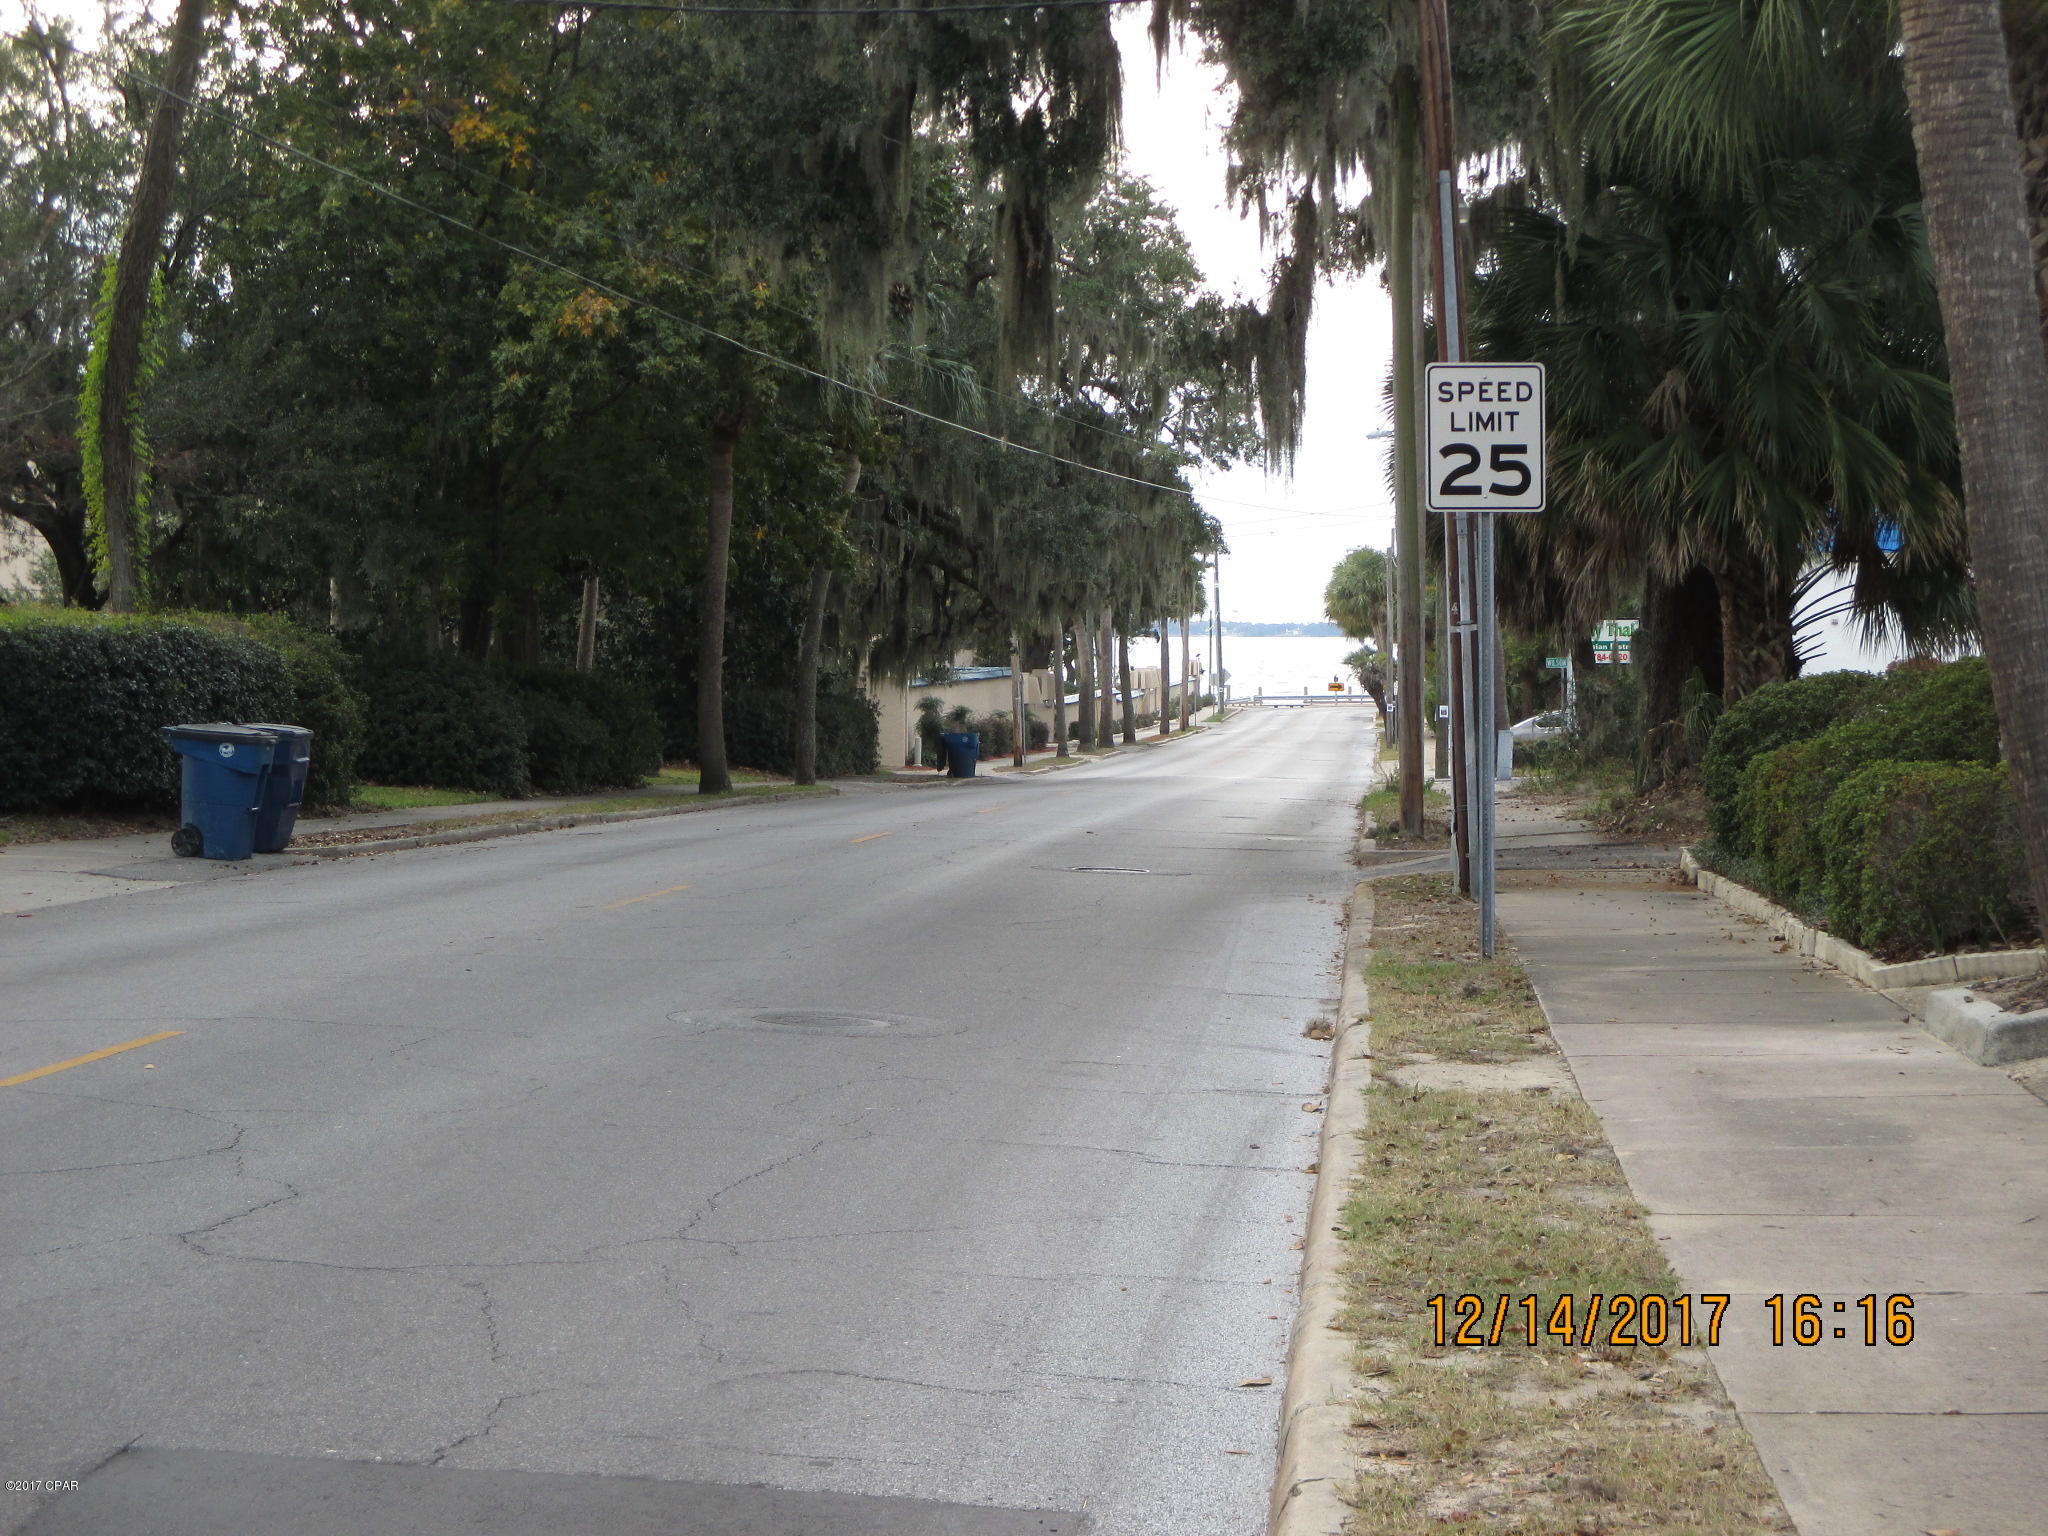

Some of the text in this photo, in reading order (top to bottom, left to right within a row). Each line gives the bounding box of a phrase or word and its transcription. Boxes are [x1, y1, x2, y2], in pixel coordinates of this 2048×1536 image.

[1438, 381, 1533, 403] SPEED
[1450, 411, 1520, 432] LIMIT
[1439, 442, 1532, 497] 25
